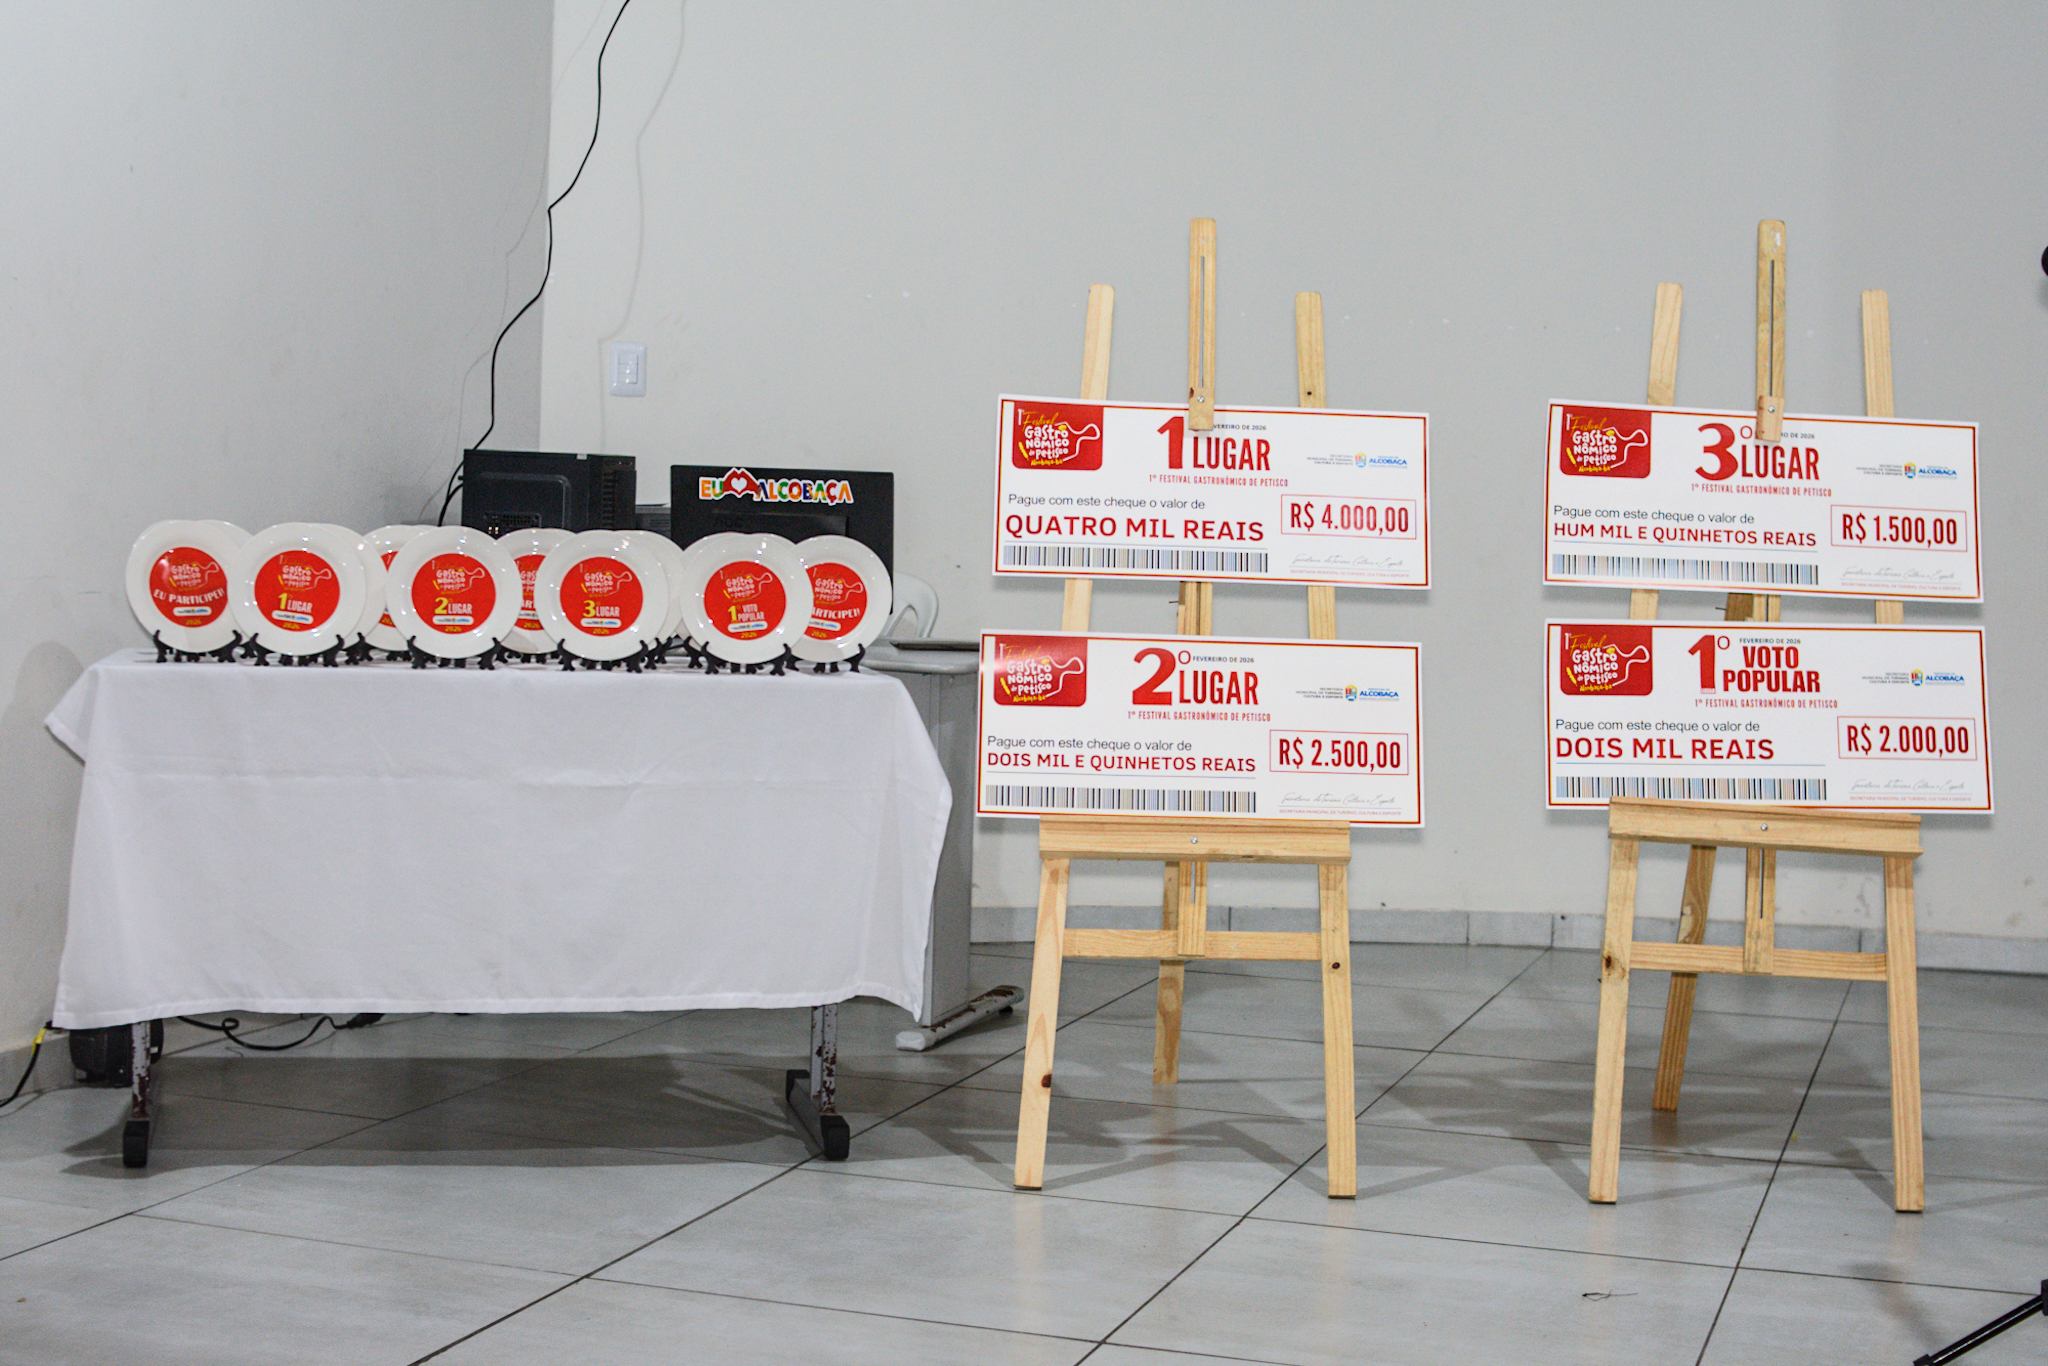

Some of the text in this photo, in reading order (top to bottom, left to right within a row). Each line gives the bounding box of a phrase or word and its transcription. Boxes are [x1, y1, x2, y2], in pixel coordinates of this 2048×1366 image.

[1024, 424, 1069, 440] Gastro
[1572, 430, 1617, 446] Gastro
[1193, 436, 1270, 470] LUGAR
[1741, 444, 1820, 480] LUGAR
[1150, 474, 1288, 487] 1º FESTIVAL GASTRONÔMICO DE PETISCO
[1919, 468, 1957, 476] ALCOBAÇA
[699, 476, 854, 506] EU ALCOBAÇA
[1692, 483, 1832, 497] 1º FESTIVAL GASTRONÔMICO DE PETISCO
[1009, 494, 1045, 506] Pague
[1077, 497, 1100, 506] este
[1104, 497, 1146, 509] cheque
[1150, 500, 1157, 508] o
[1160, 498, 1187, 509] valor
[1191, 500, 1205, 509] de
[1291, 502, 1408, 535] R$ 4.000,00
[1554, 505, 1754, 523] Pague com este cheque o valor de
[1006, 515, 1263, 541] QUATRO MIL REAIS
[1555, 523, 1816, 546] HUM MIL E QUINHETOS REAIS
[1843, 513, 1957, 547] R$ 1.500,00
[153, 589, 167, 600] EU
[287, 599, 313, 613] LUGAR
[448, 603, 472, 614] LUGAR
[596, 606, 620, 617] LUGAR
[738, 611, 765, 622] POPULAR
[1572, 647, 1617, 664] Gastro
[1742, 646, 1799, 669] VOTO
[1007, 658, 1052, 675] Gastro
[1179, 670, 1259, 705] LUGAR
[1723, 670, 1820, 692] POPULAR
[1695, 698, 1838, 709] 1º FESTIVAL GASTRONÔMICO DE PETISCO
[1128, 710, 1271, 722] 1º FESTIVAL GASTRONÔMICO DE PETISCO
[1556, 719, 1760, 733] Pague com este cheque o valor de
[988, 736, 1191, 751] Pague com este cheque o valor de
[1557, 737, 1774, 759] DOIS MIL REAIS
[1847, 723, 1969, 757] R$ 2.000,00
[988, 753, 1255, 772] DOIS MIL E QUINHETOS REAIS
[1280, 737, 1400, 772] R$ 2.500,00
